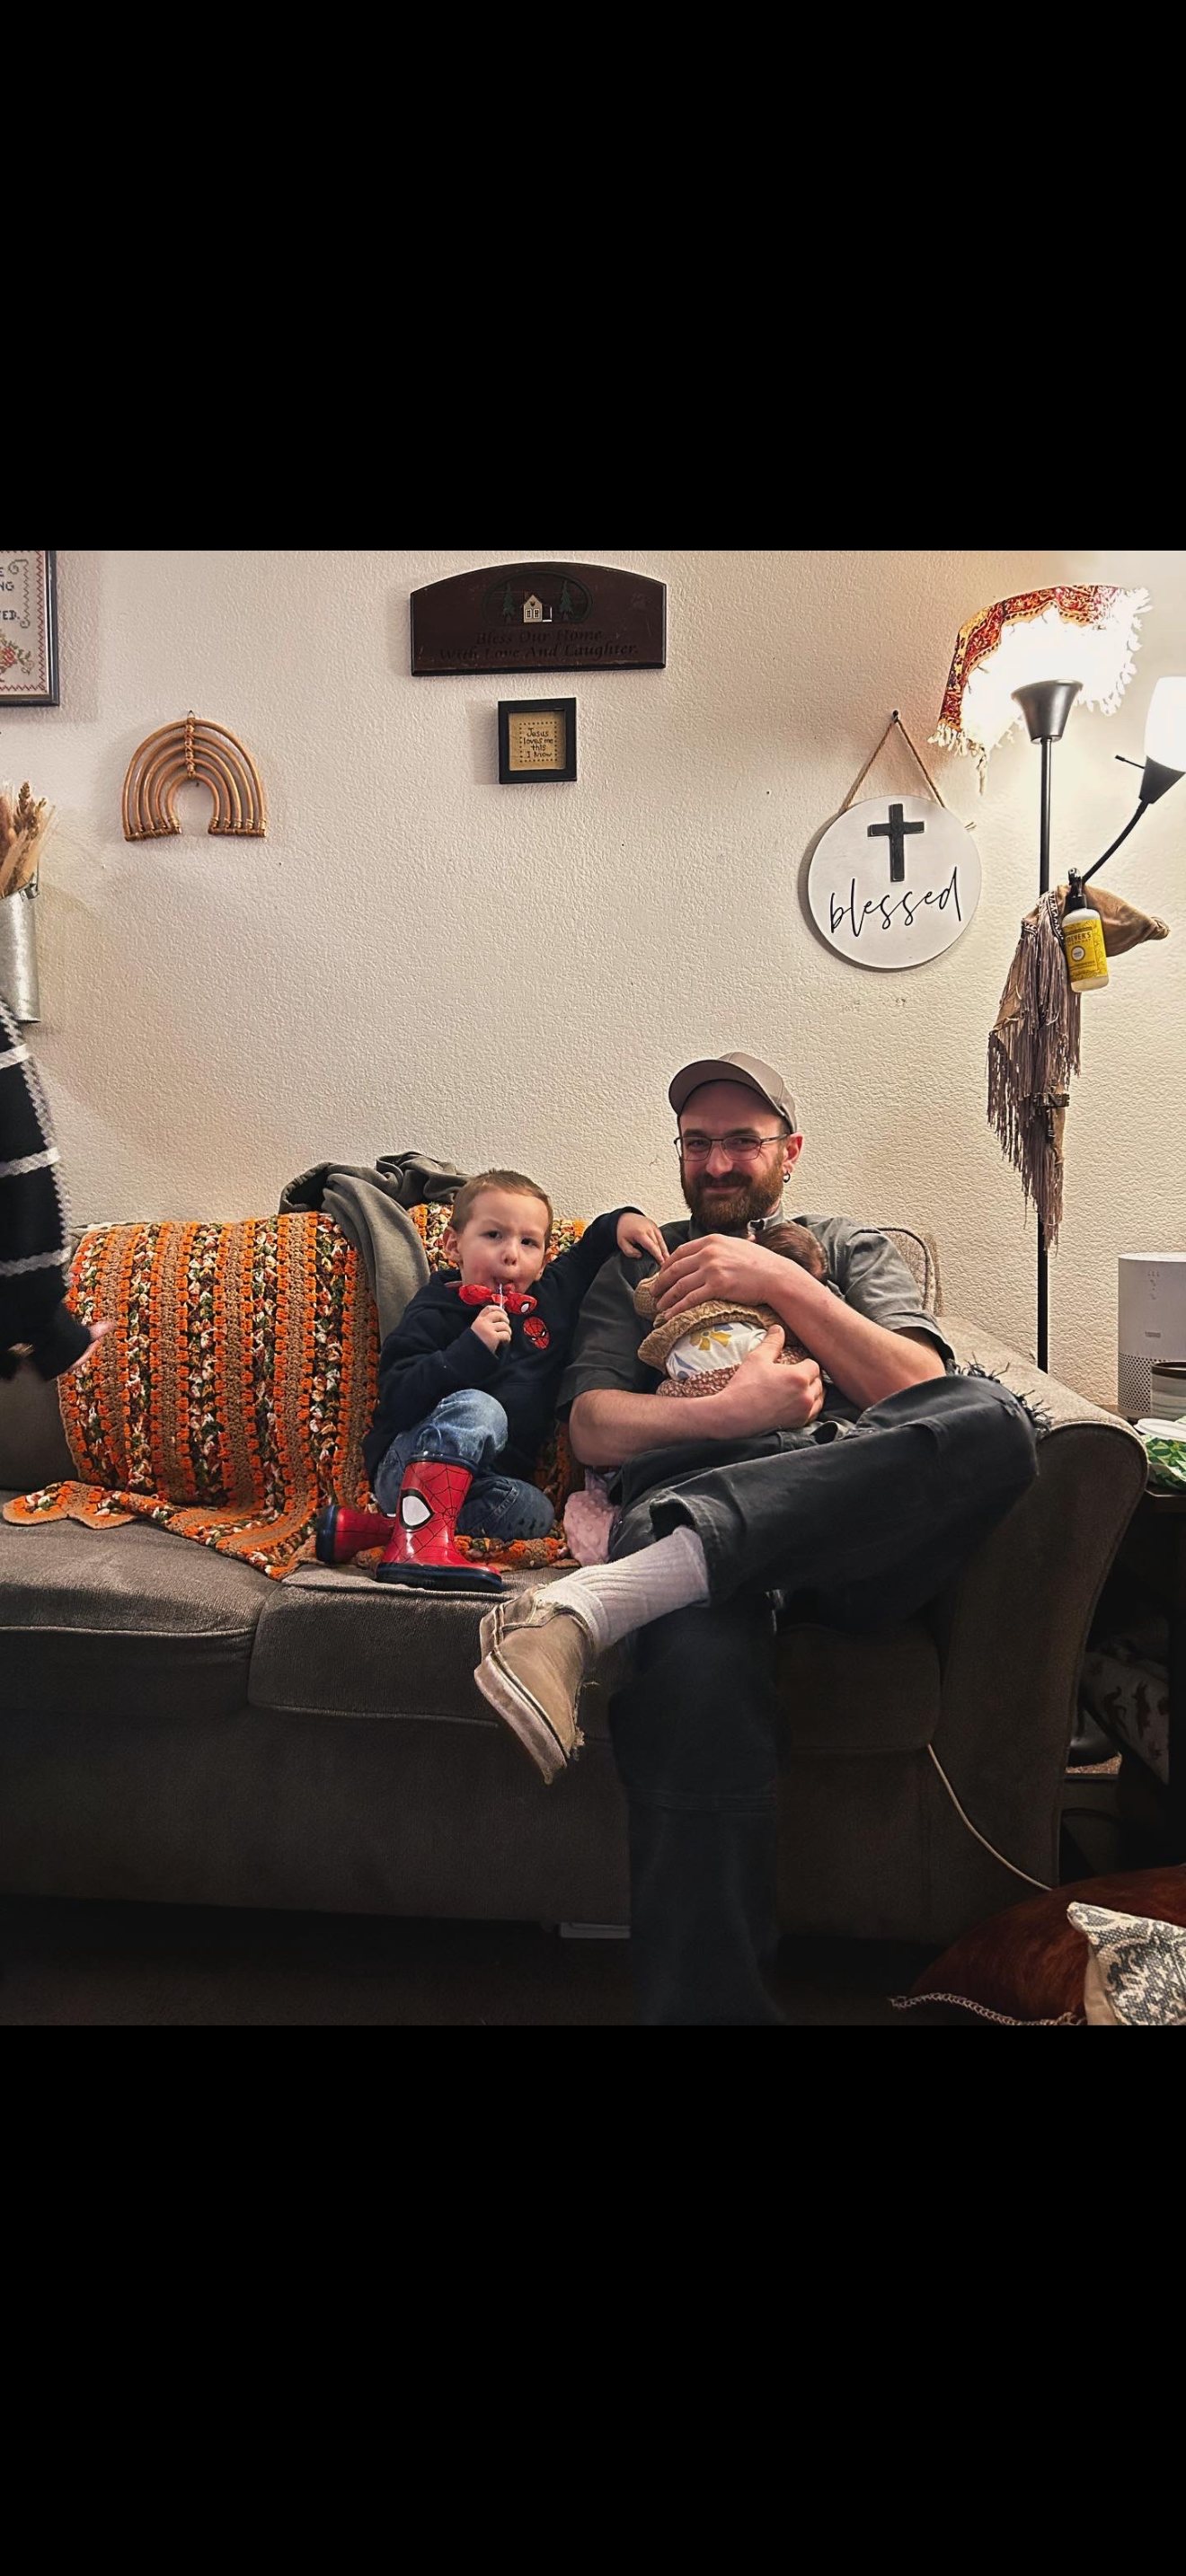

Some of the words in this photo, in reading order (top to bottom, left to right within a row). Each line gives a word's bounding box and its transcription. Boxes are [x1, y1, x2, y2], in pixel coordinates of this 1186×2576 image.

[0, 610, 20, 620] ED.
[476, 631, 512, 645] Bless
[519, 630, 550, 644] Our
[556, 629, 603, 643] Home
[439, 645, 478, 660] With
[486, 646, 520, 659] Love
[526, 643, 557, 658] And
[565, 640, 639, 661] Laughter.
[527, 728, 549, 737] Jesus
[829, 866, 962, 938] blessed
